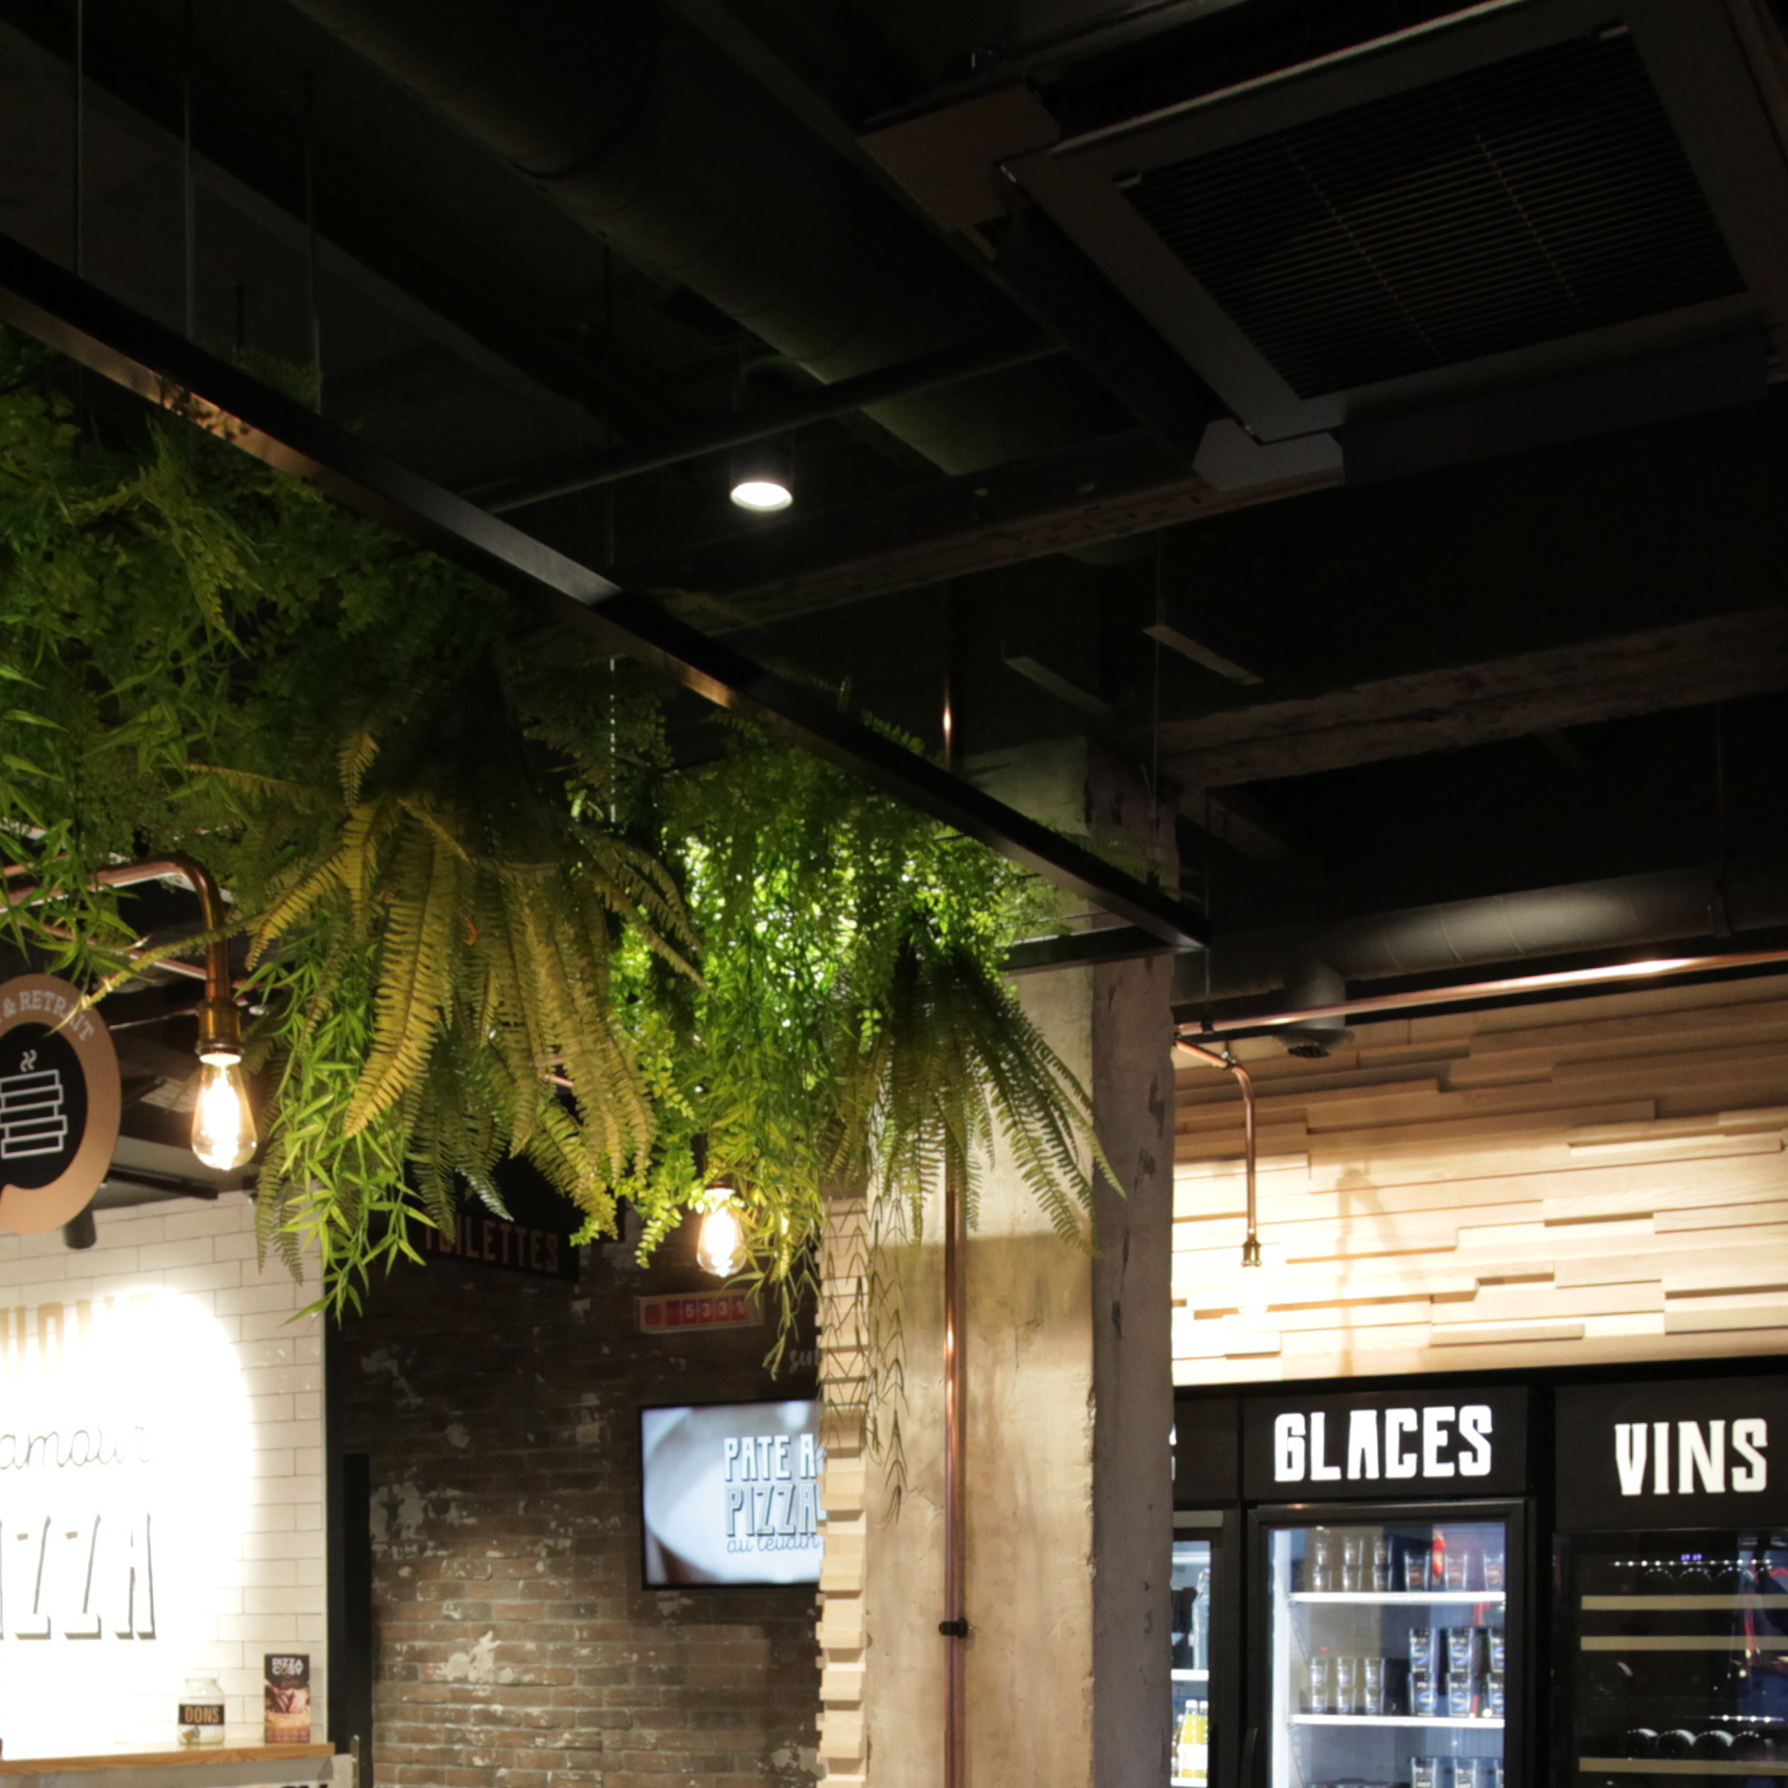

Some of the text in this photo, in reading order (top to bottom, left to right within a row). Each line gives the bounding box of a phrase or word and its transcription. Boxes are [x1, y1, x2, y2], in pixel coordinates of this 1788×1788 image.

[3, 997, 17, 1018] &
[723, 1436, 792, 1482] PATE
[1274, 1405, 1768, 1495] GLACES VINS
[724, 1483, 819, 1537] PIZZA
[726, 1529, 821, 1553] au levain
[271, 1657, 304, 1667] PIZZA
[184, 1706, 220, 1724] DONS
